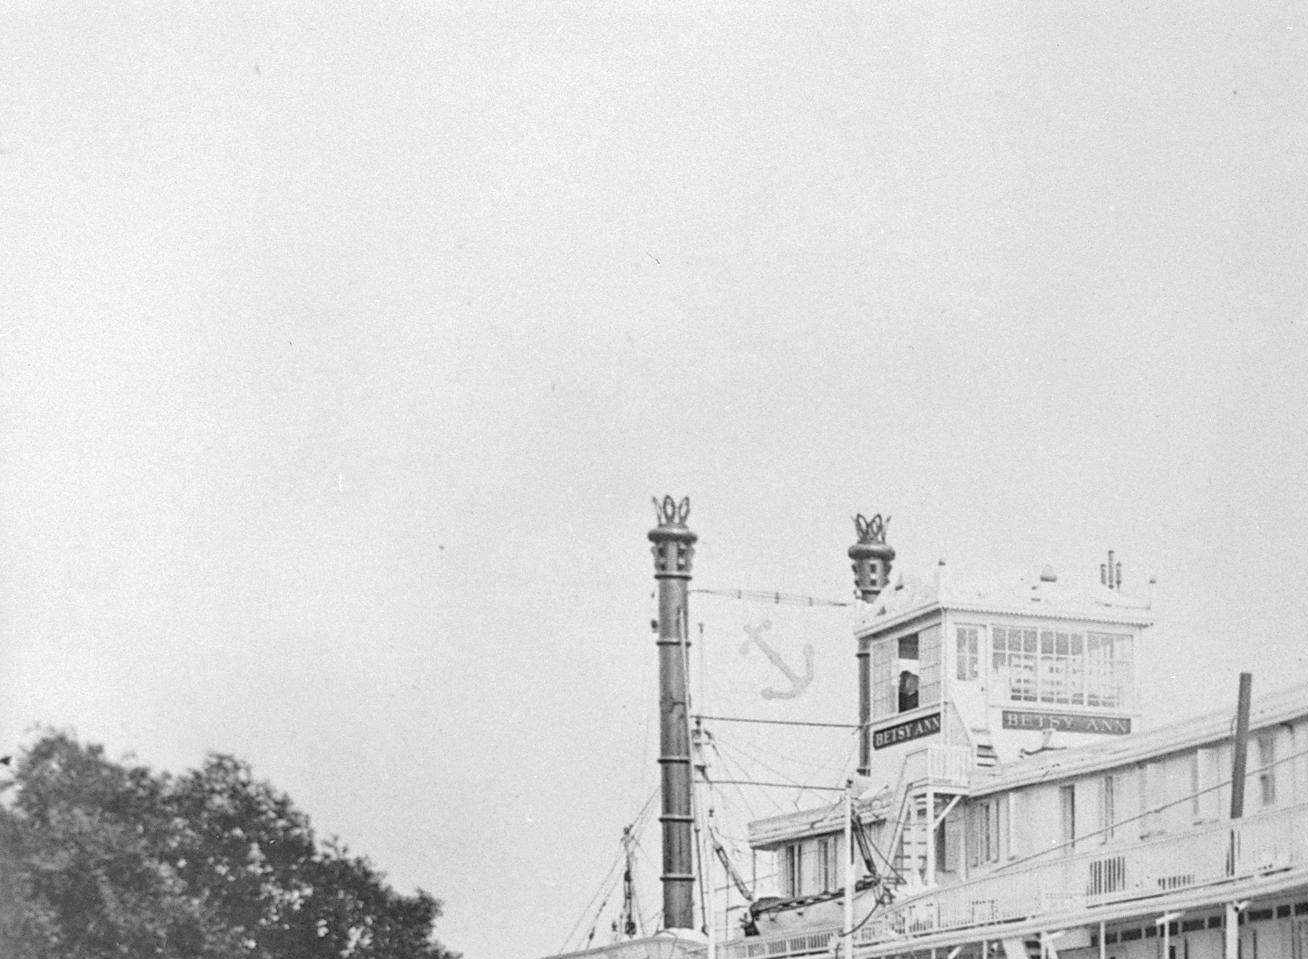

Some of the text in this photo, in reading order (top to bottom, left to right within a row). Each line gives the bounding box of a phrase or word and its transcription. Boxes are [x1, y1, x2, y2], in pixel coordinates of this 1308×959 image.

[875, 715, 940, 746] BETSY ANN
[1008, 713, 1126, 732] BETSY ANN
